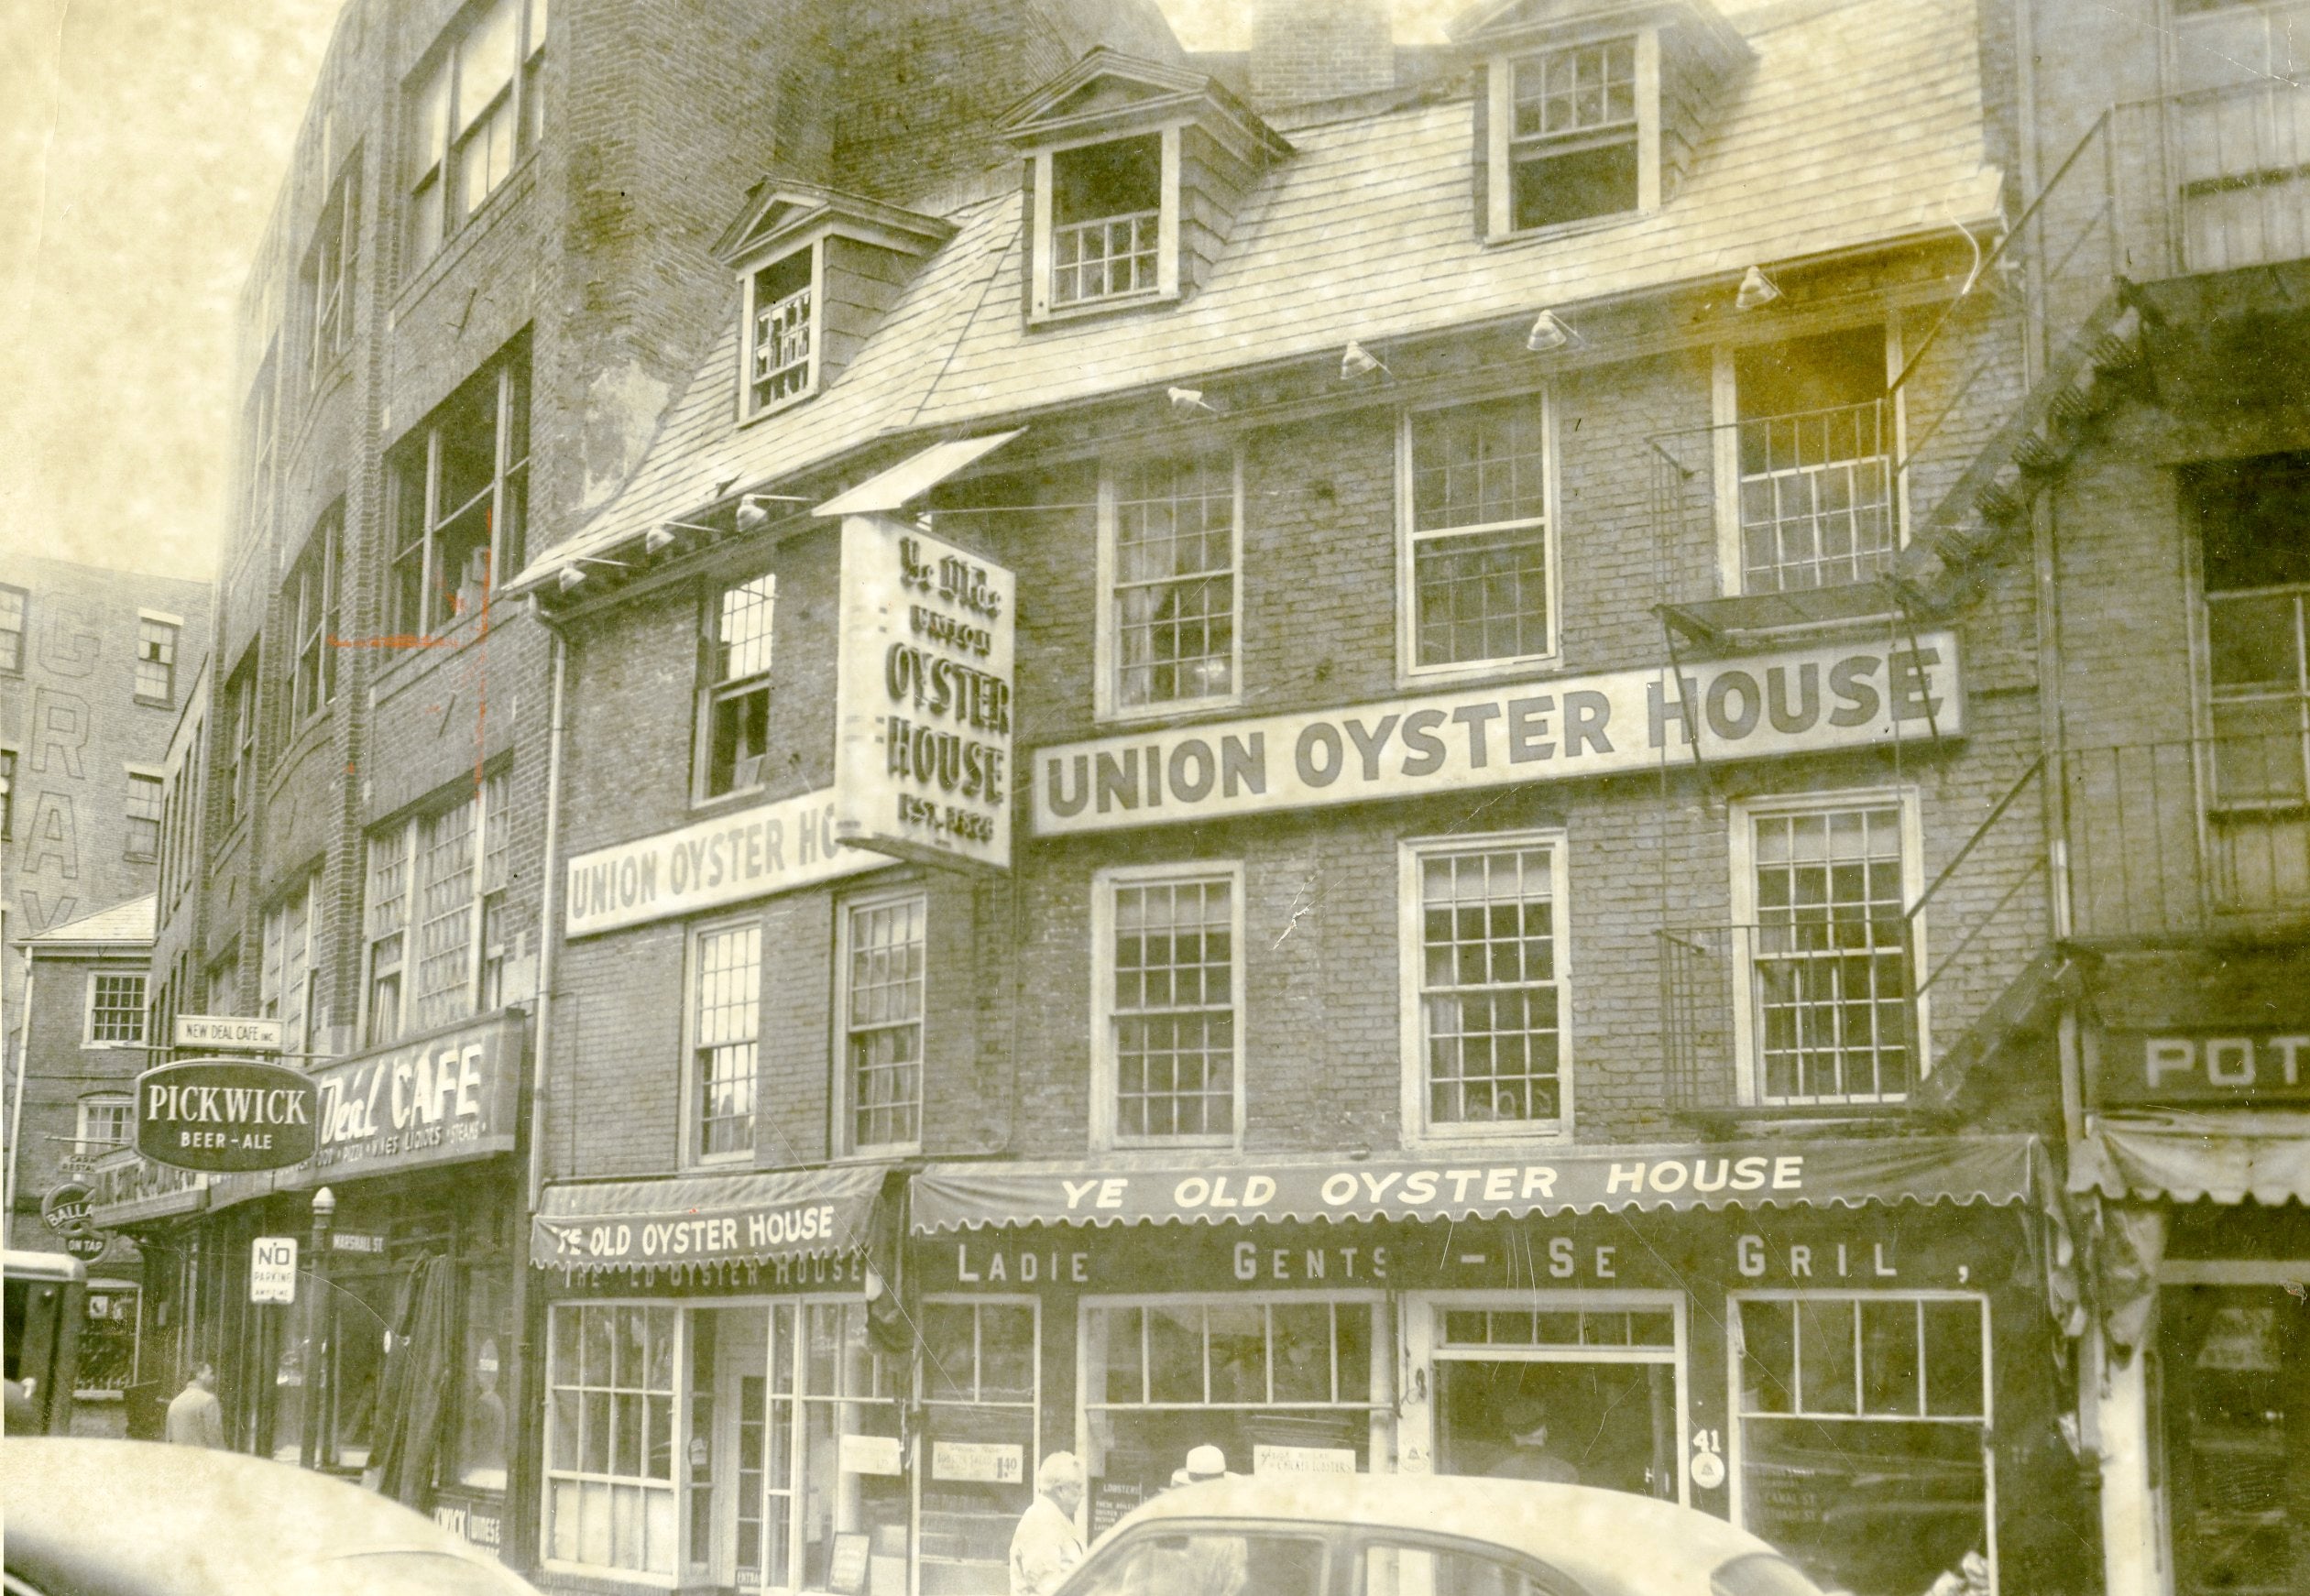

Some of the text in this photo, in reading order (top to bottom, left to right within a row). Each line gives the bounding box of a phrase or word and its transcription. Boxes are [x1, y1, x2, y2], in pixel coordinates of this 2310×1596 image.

[909, 604, 991, 657] UNION
[885, 641, 1010, 735] OYSTER
[1047, 646, 1944, 819] UNION OYSTER HOUSE
[886, 715, 1005, 805] HOUSE
[573, 850, 658, 919] UNION
[670, 818, 785, 896] OYSTER
[186, 1023, 208, 1038] NEW
[211, 1024, 233, 1041] DEAL
[235, 1025, 258, 1042] CAFE
[147, 1085, 309, 1125] PICKWICK
[391, 1043, 484, 1131] CAFE
[181, 1131, 225, 1149] BEER
[242, 1133, 272, 1151] ALE
[1060, 1155, 1805, 1209] YE OLD OYSTER HOUSE
[46, 1202, 93, 1229] BALLA
[589, 1224, 631, 1257] OLD
[642, 1216, 739, 1256] OYSTER
[749, 1206, 835, 1248] HOUSE
[67, 1238, 104, 1252] ON TAP
[257, 1247, 290, 1266] NO
[254, 1271, 292, 1283] PARKING
[1691, 1428, 1722, 1454] 41
[737, 1570, 760, 1584] ENTRA
